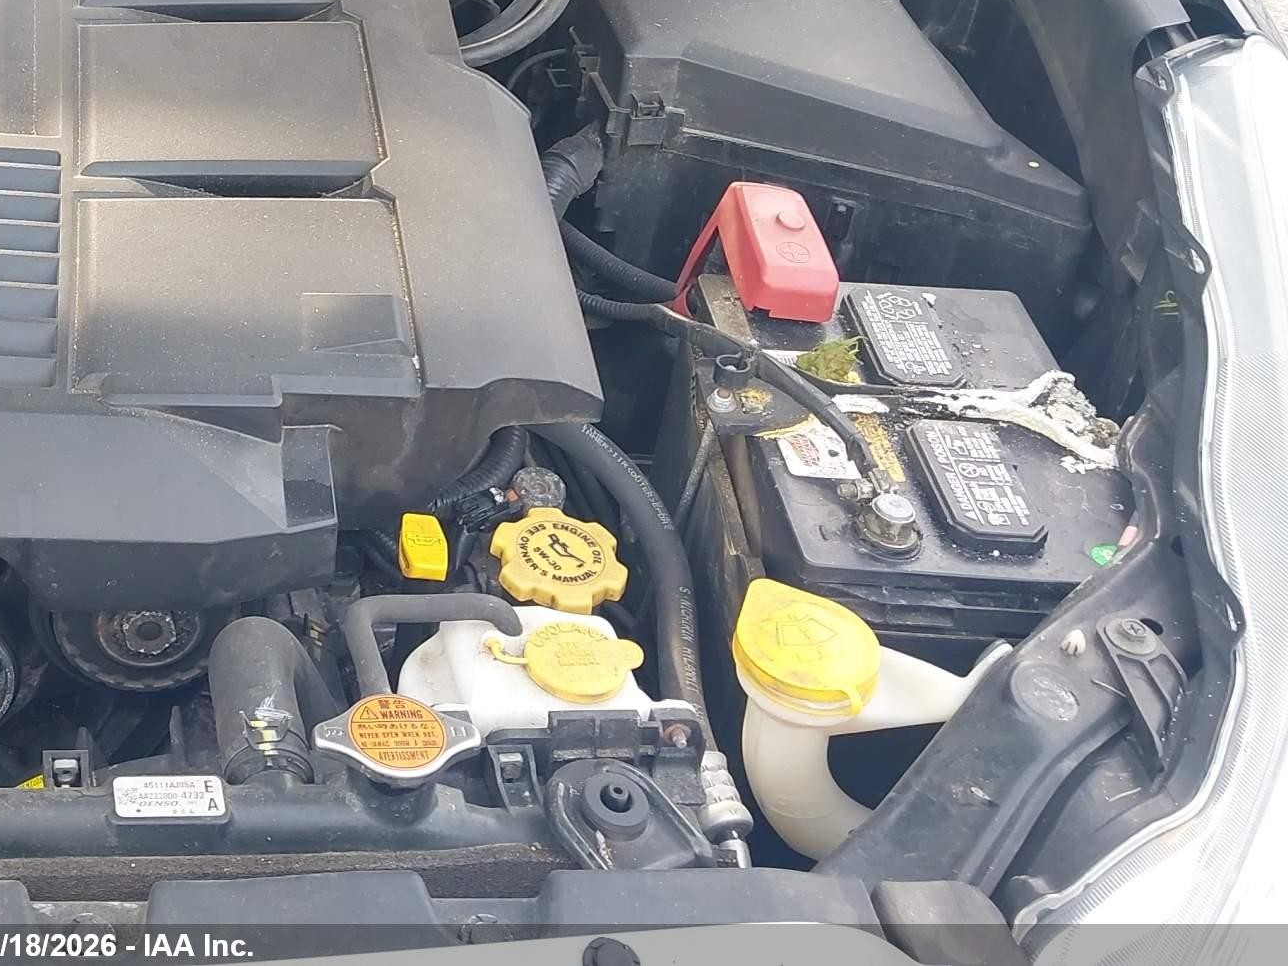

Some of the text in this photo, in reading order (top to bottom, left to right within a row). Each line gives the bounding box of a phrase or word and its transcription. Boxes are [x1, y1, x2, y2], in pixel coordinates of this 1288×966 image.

[552, 522, 603, 565] ENGINE OIL
[517, 523, 598, 583] SEE OWNER'S MANUAL
[533, 546, 562, 571] 5W-30
[378, 699, 406, 709] 警告
[379, 709, 423, 720] WARNING
[203, 780, 214, 793] E
[138, 800, 179, 808] DENSO
[207, 797, 220, 812] A
